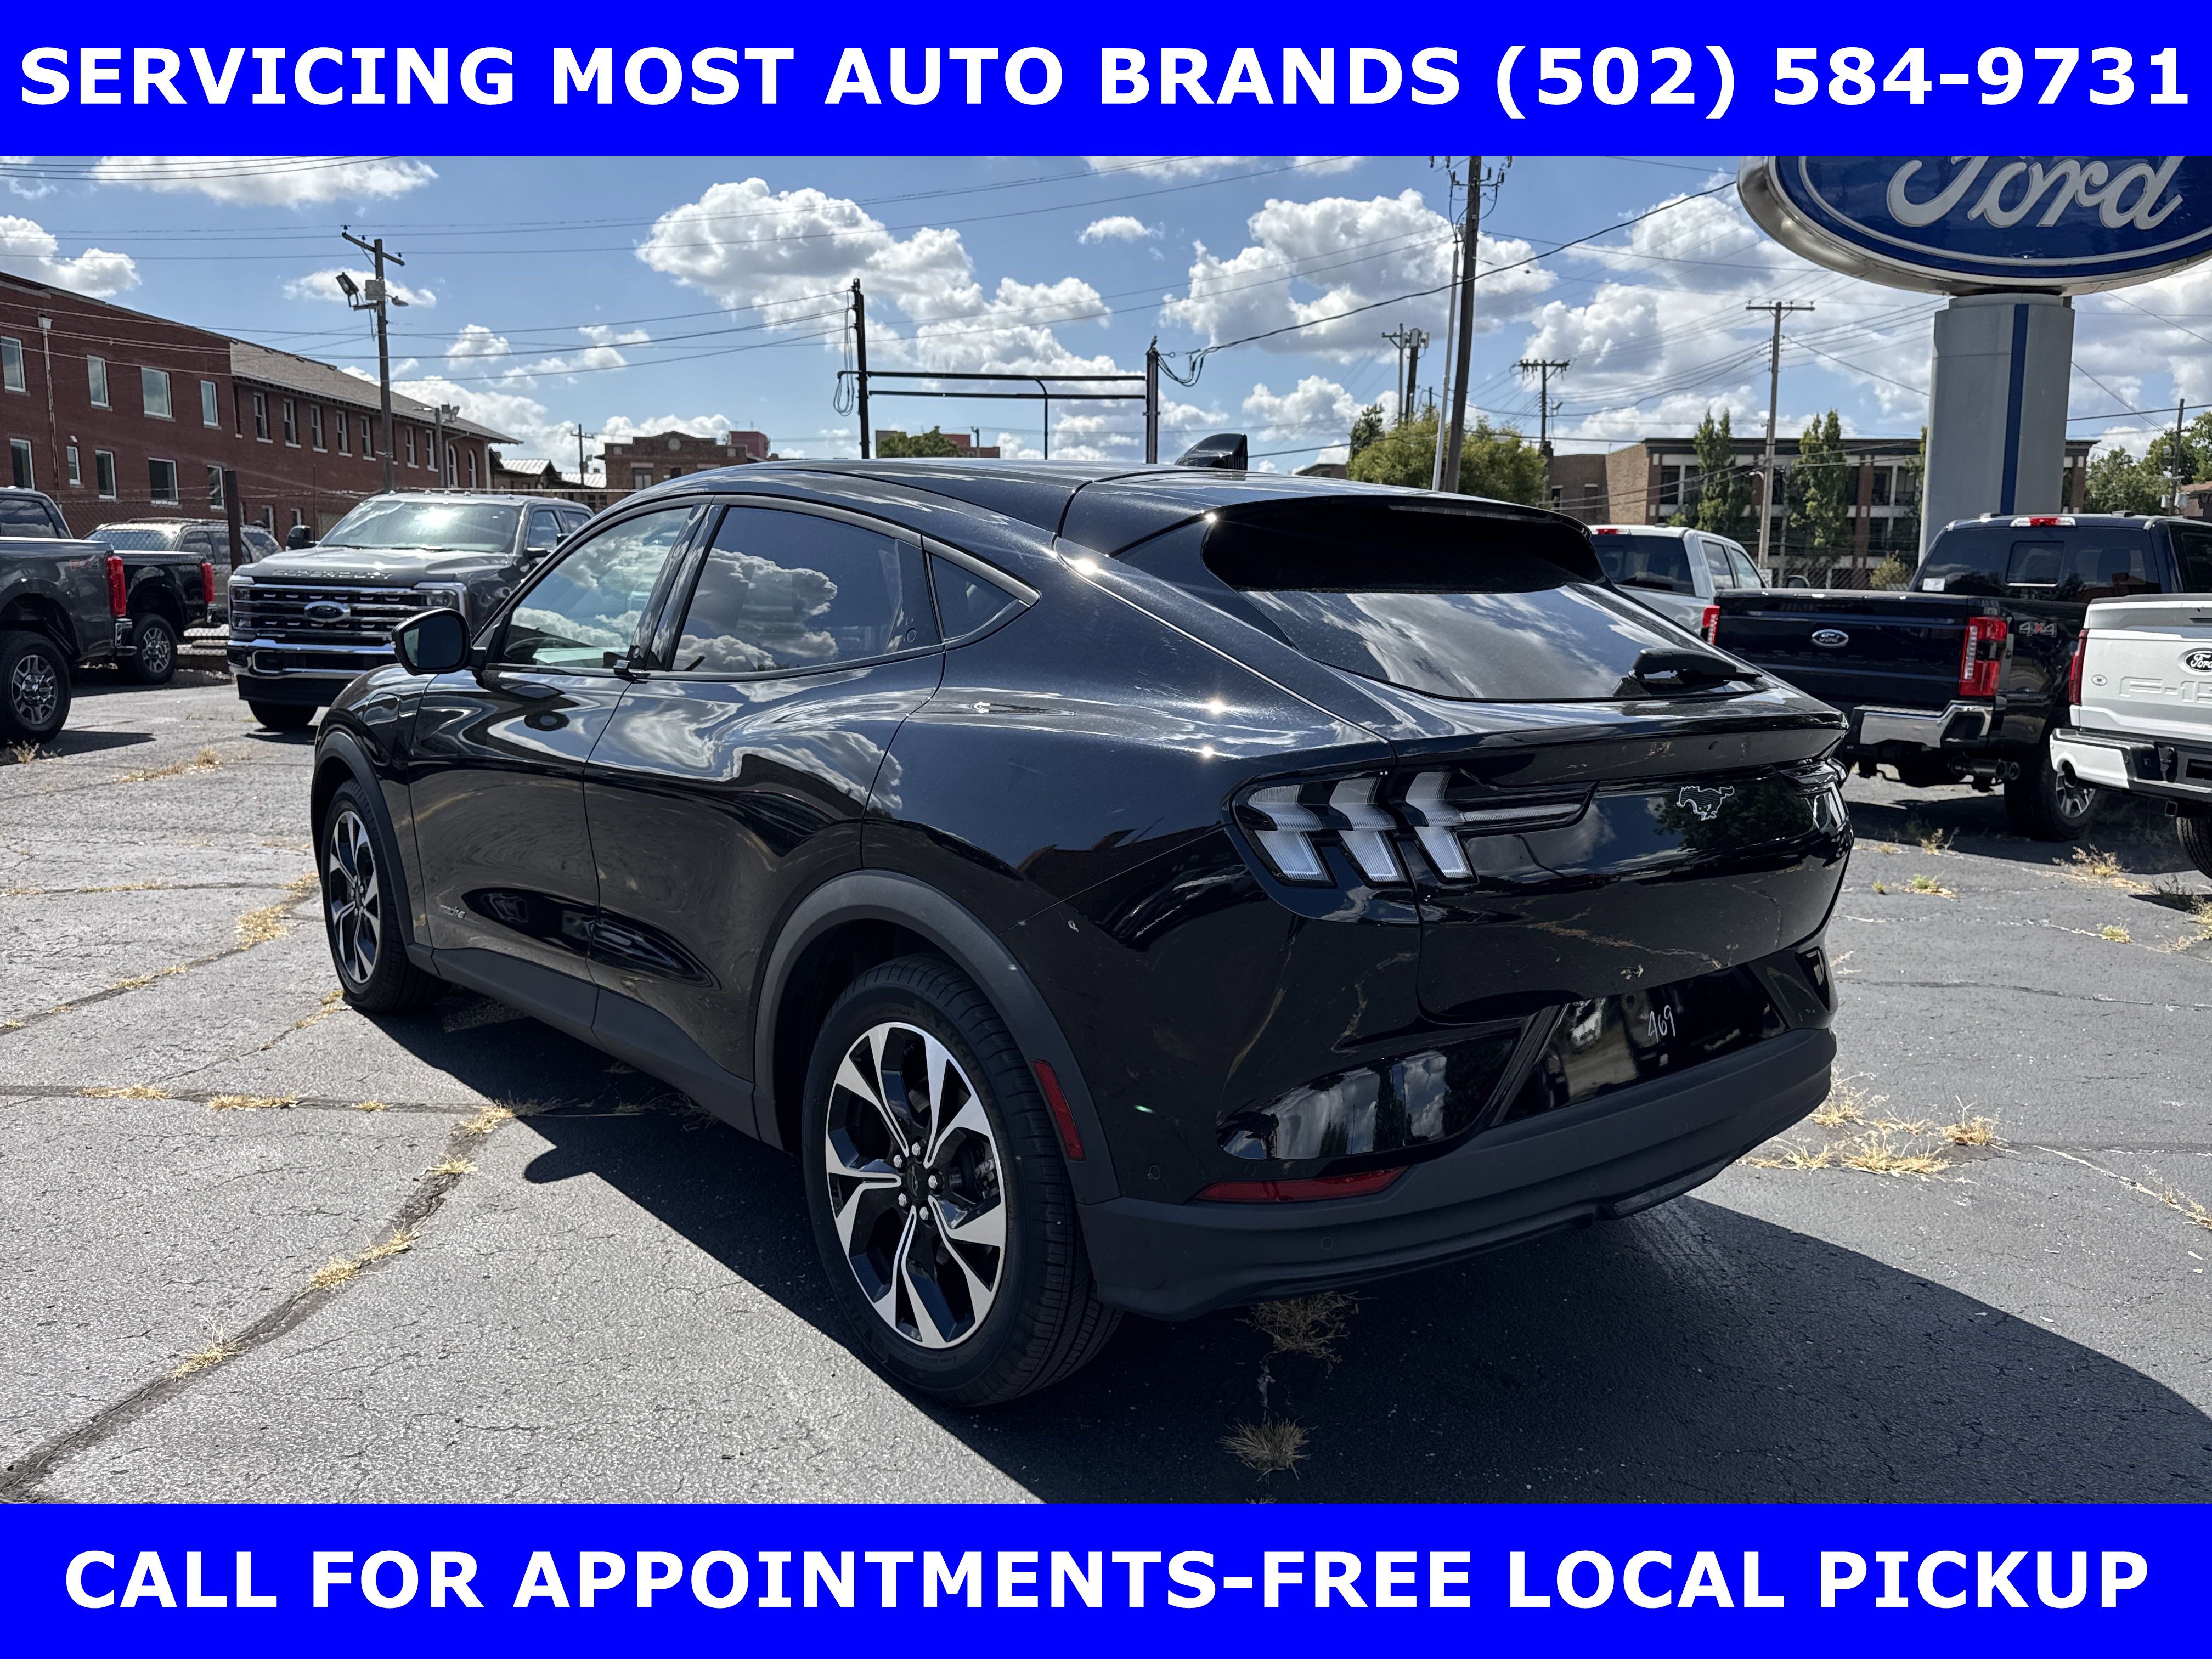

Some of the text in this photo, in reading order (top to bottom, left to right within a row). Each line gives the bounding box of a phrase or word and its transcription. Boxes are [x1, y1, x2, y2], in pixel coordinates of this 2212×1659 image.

[272, 569, 393, 580] SUPER DUTY
[1647, 1005, 1676, 1043] 469
